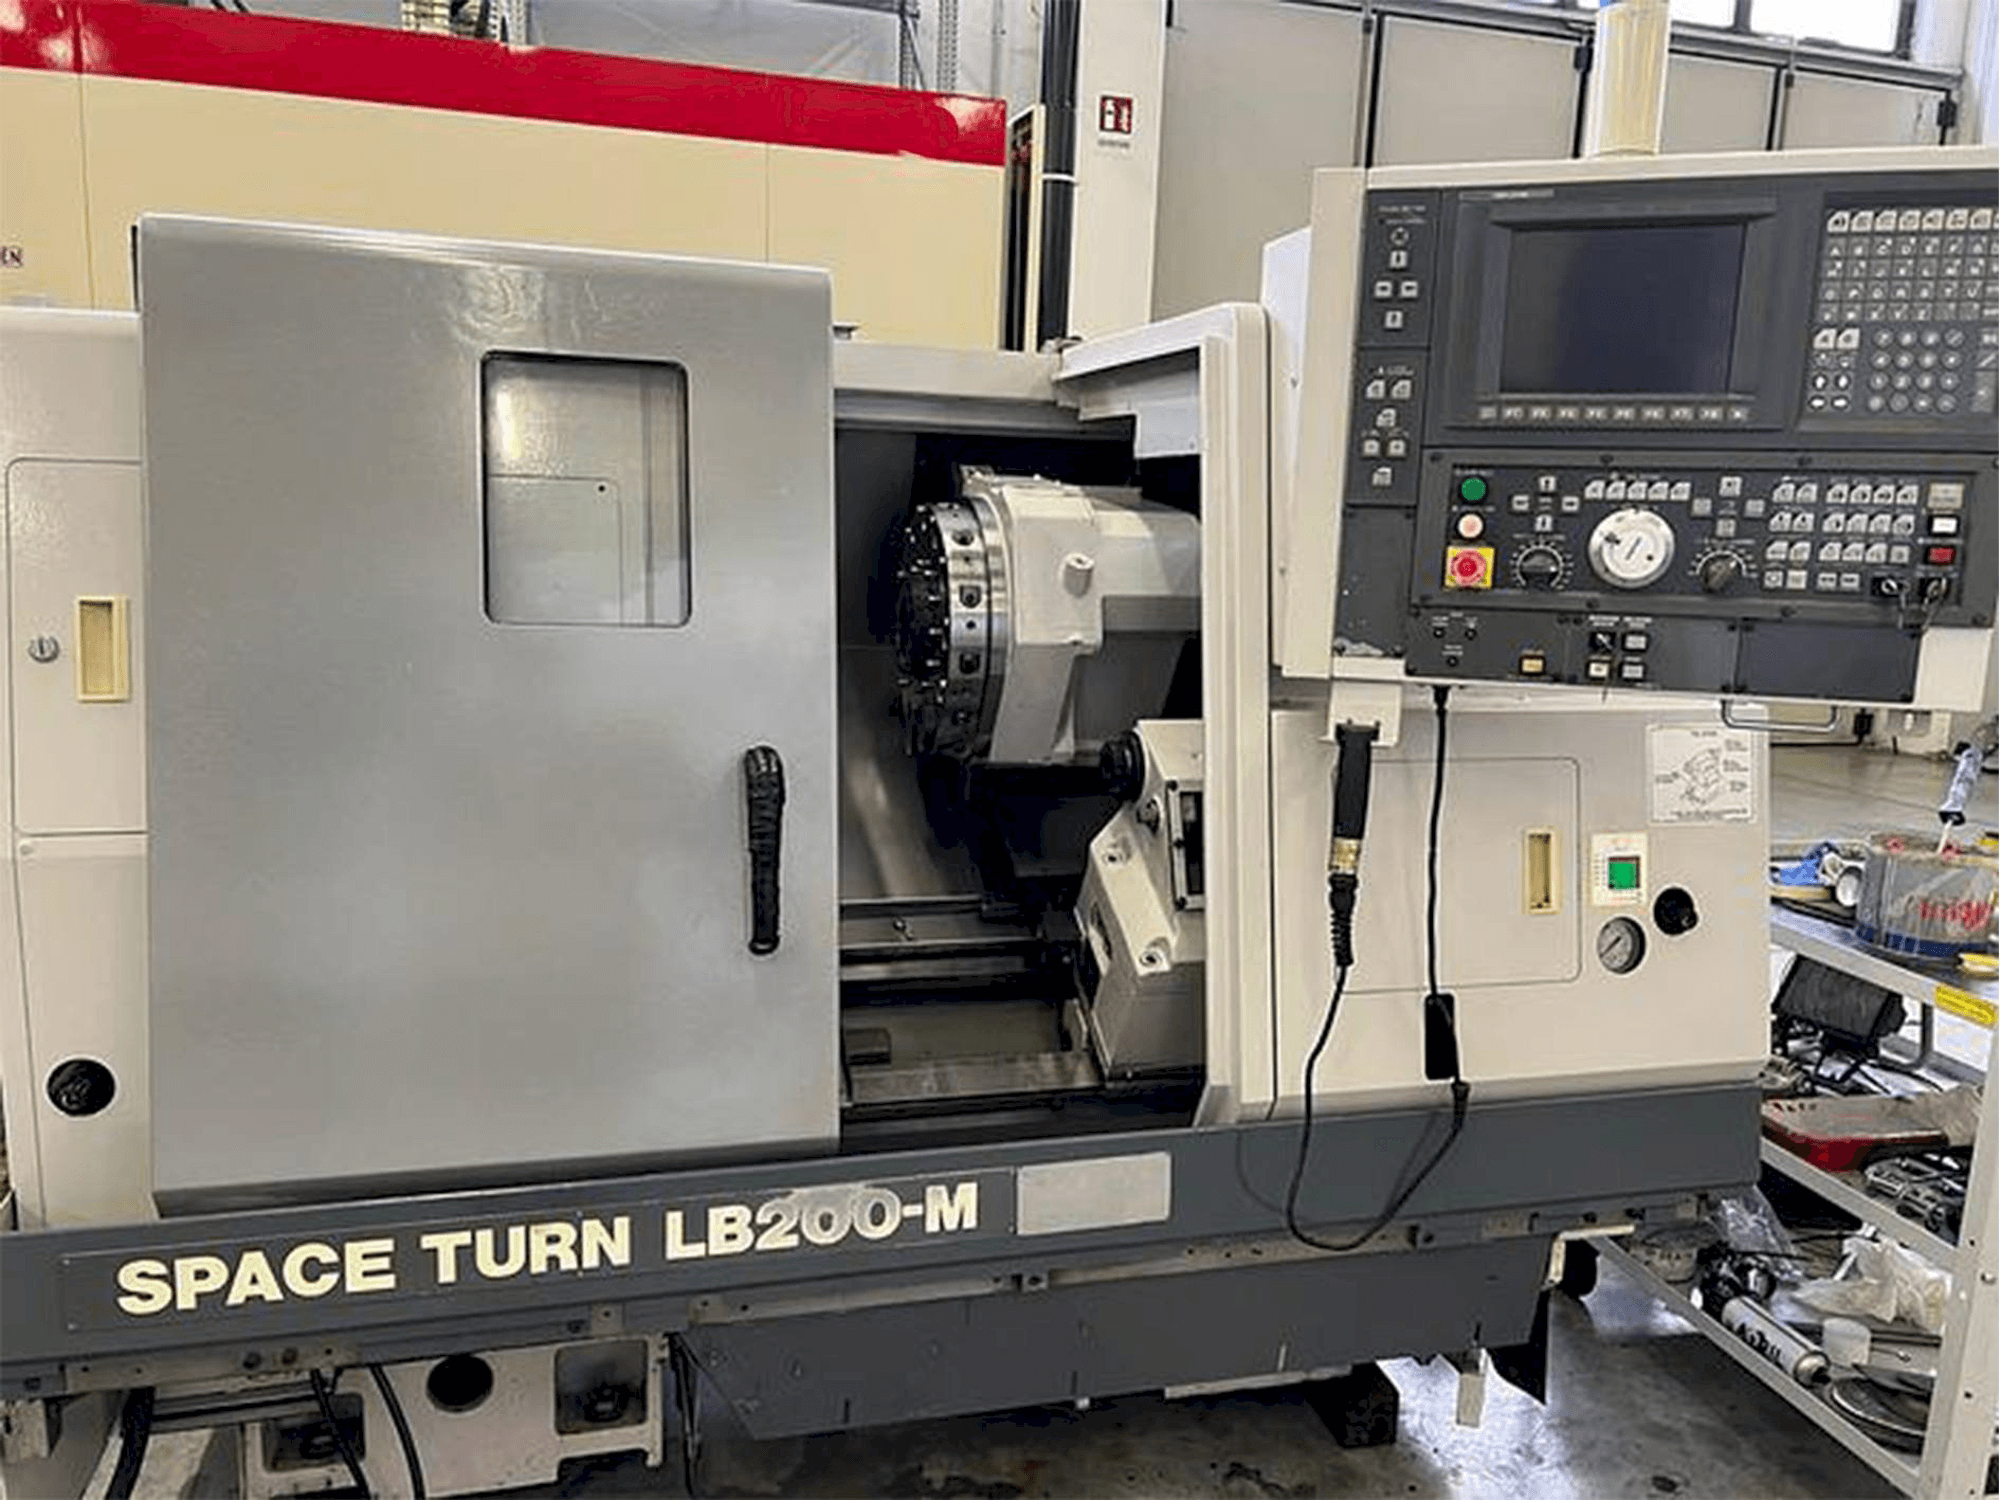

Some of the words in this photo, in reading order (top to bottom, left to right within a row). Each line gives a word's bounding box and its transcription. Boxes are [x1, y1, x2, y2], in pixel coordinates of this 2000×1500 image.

[118, 1238, 396, 1315] SPACE
[420, 1216, 631, 1284] TURN
[665, 1182, 979, 1261] LB200-M
